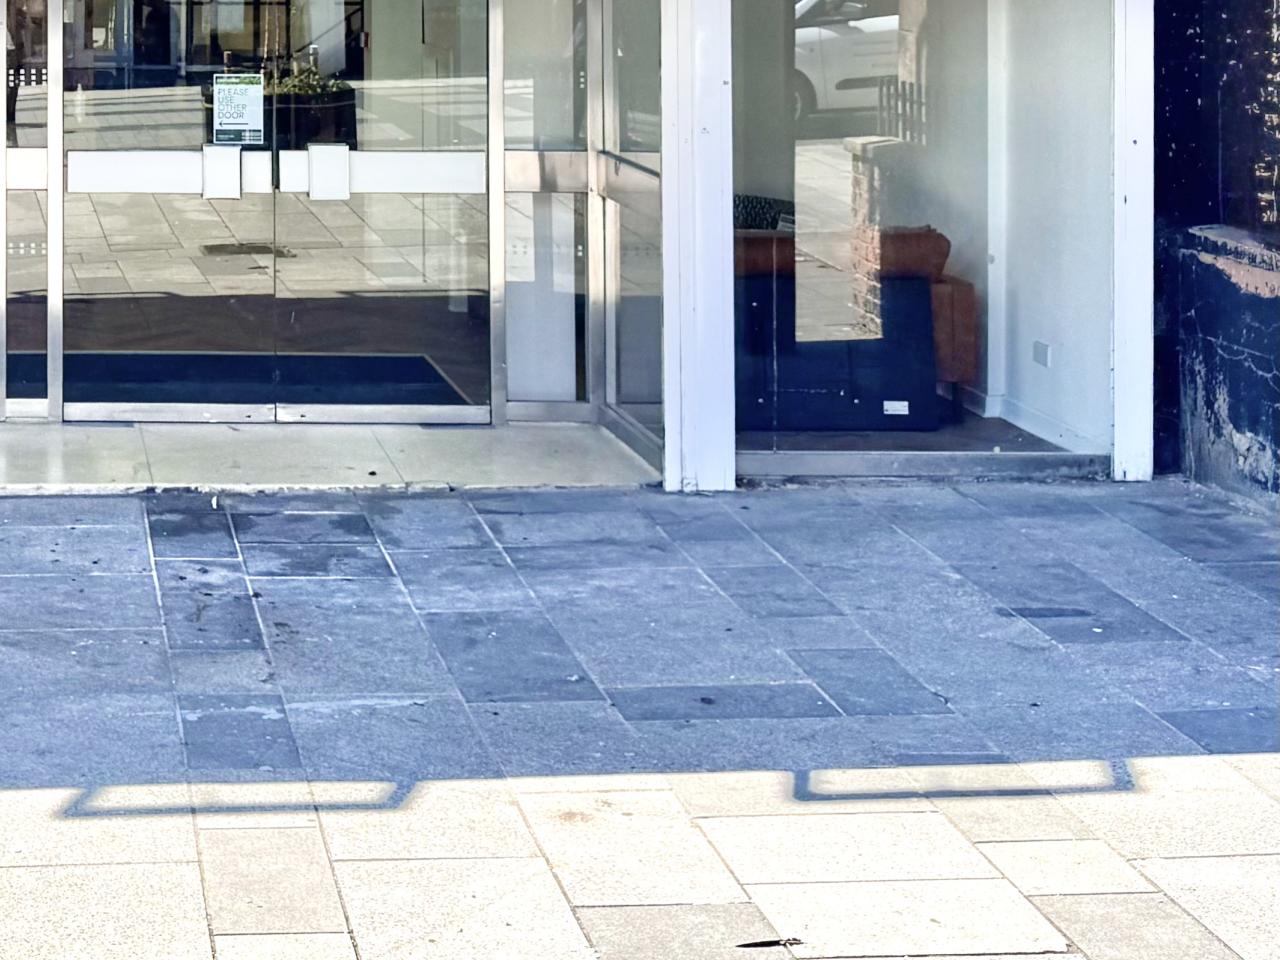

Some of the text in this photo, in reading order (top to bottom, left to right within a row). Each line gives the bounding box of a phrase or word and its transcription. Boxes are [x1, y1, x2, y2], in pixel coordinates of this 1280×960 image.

[217, 88, 249, 96] PLEASE
[217, 96, 235, 104] USE
[217, 103, 247, 112] OTHER
[217, 111, 245, 120] DOOR
